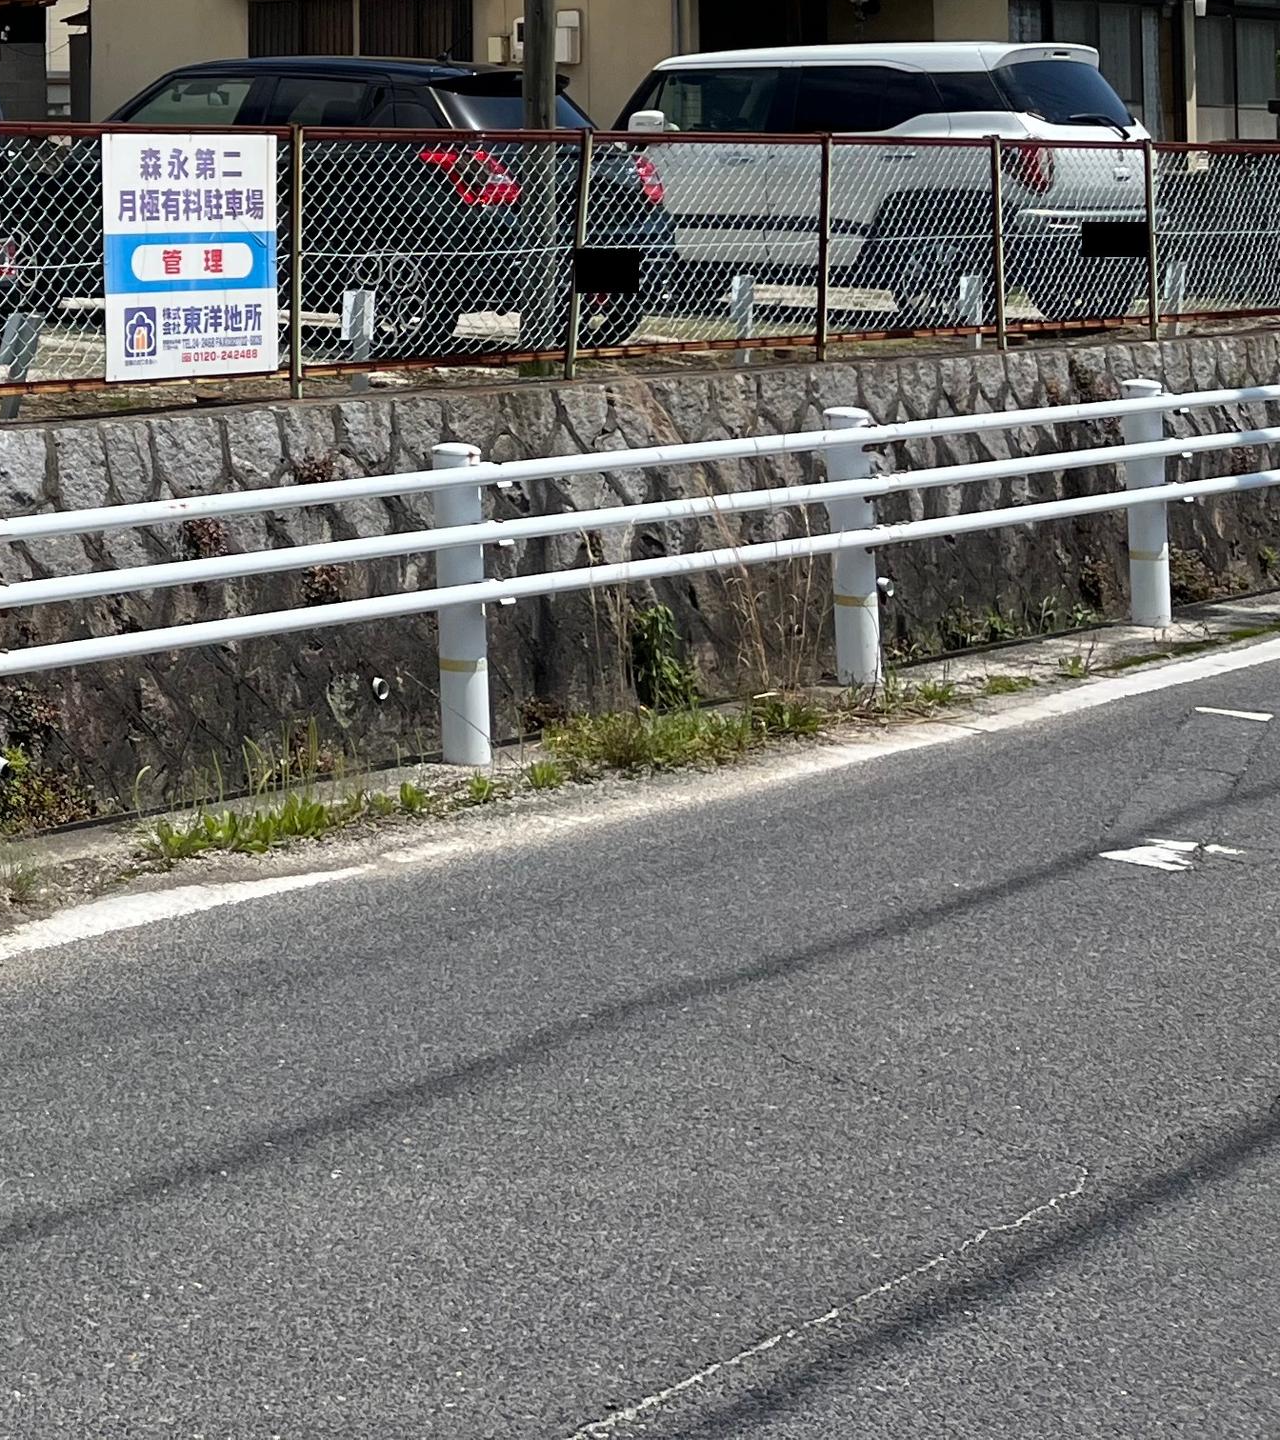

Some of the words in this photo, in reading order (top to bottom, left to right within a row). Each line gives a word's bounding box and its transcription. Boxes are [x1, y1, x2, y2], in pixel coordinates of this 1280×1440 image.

[140, 148, 242, 180] 森永第二
[118, 188, 264, 221] 月極有料駐車場
[163, 249, 223, 274] 管理
[182, 304, 262, 334] 東洋地所
